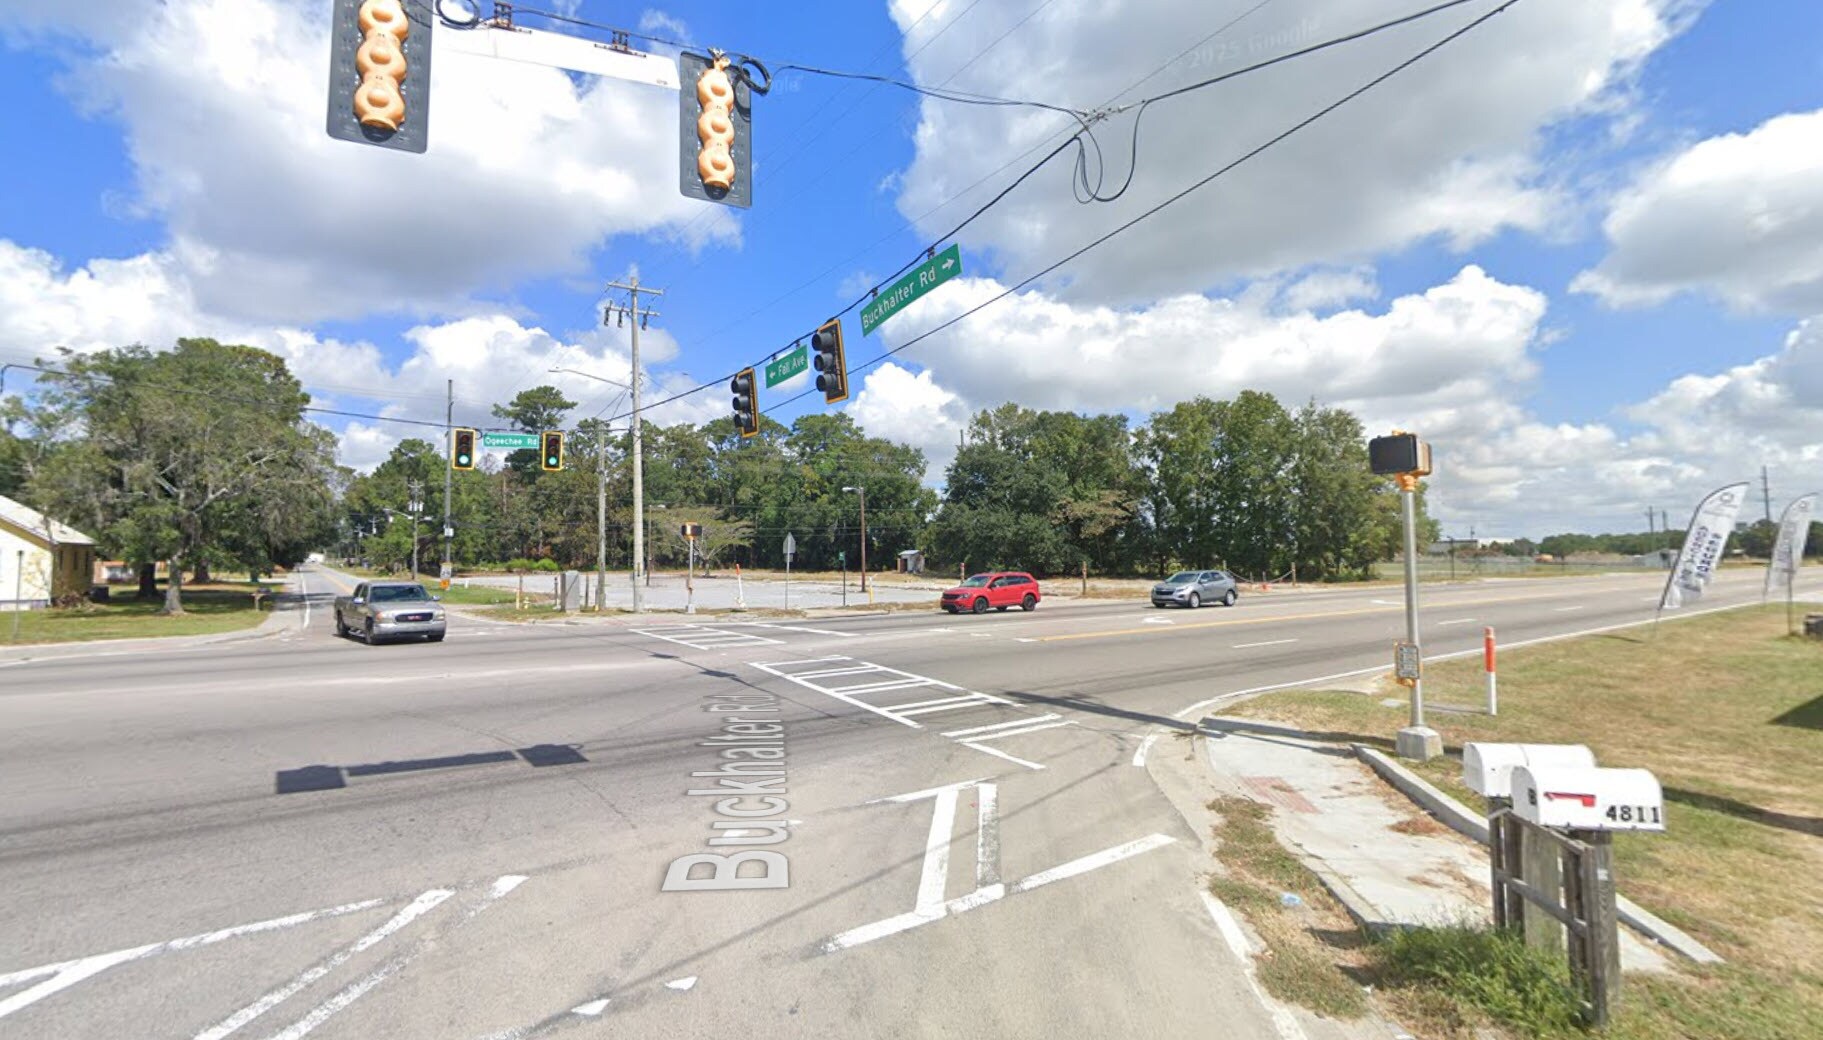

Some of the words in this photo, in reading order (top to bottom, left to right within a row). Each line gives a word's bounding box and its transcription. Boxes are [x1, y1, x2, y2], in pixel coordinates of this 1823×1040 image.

[862, 282, 915, 329] Buckhalter
[919, 265, 937, 288] Rd
[791, 354, 806, 370] Ave
[485, 437, 522, 446] Ogeechee
[1605, 804, 1661, 824] 4811
